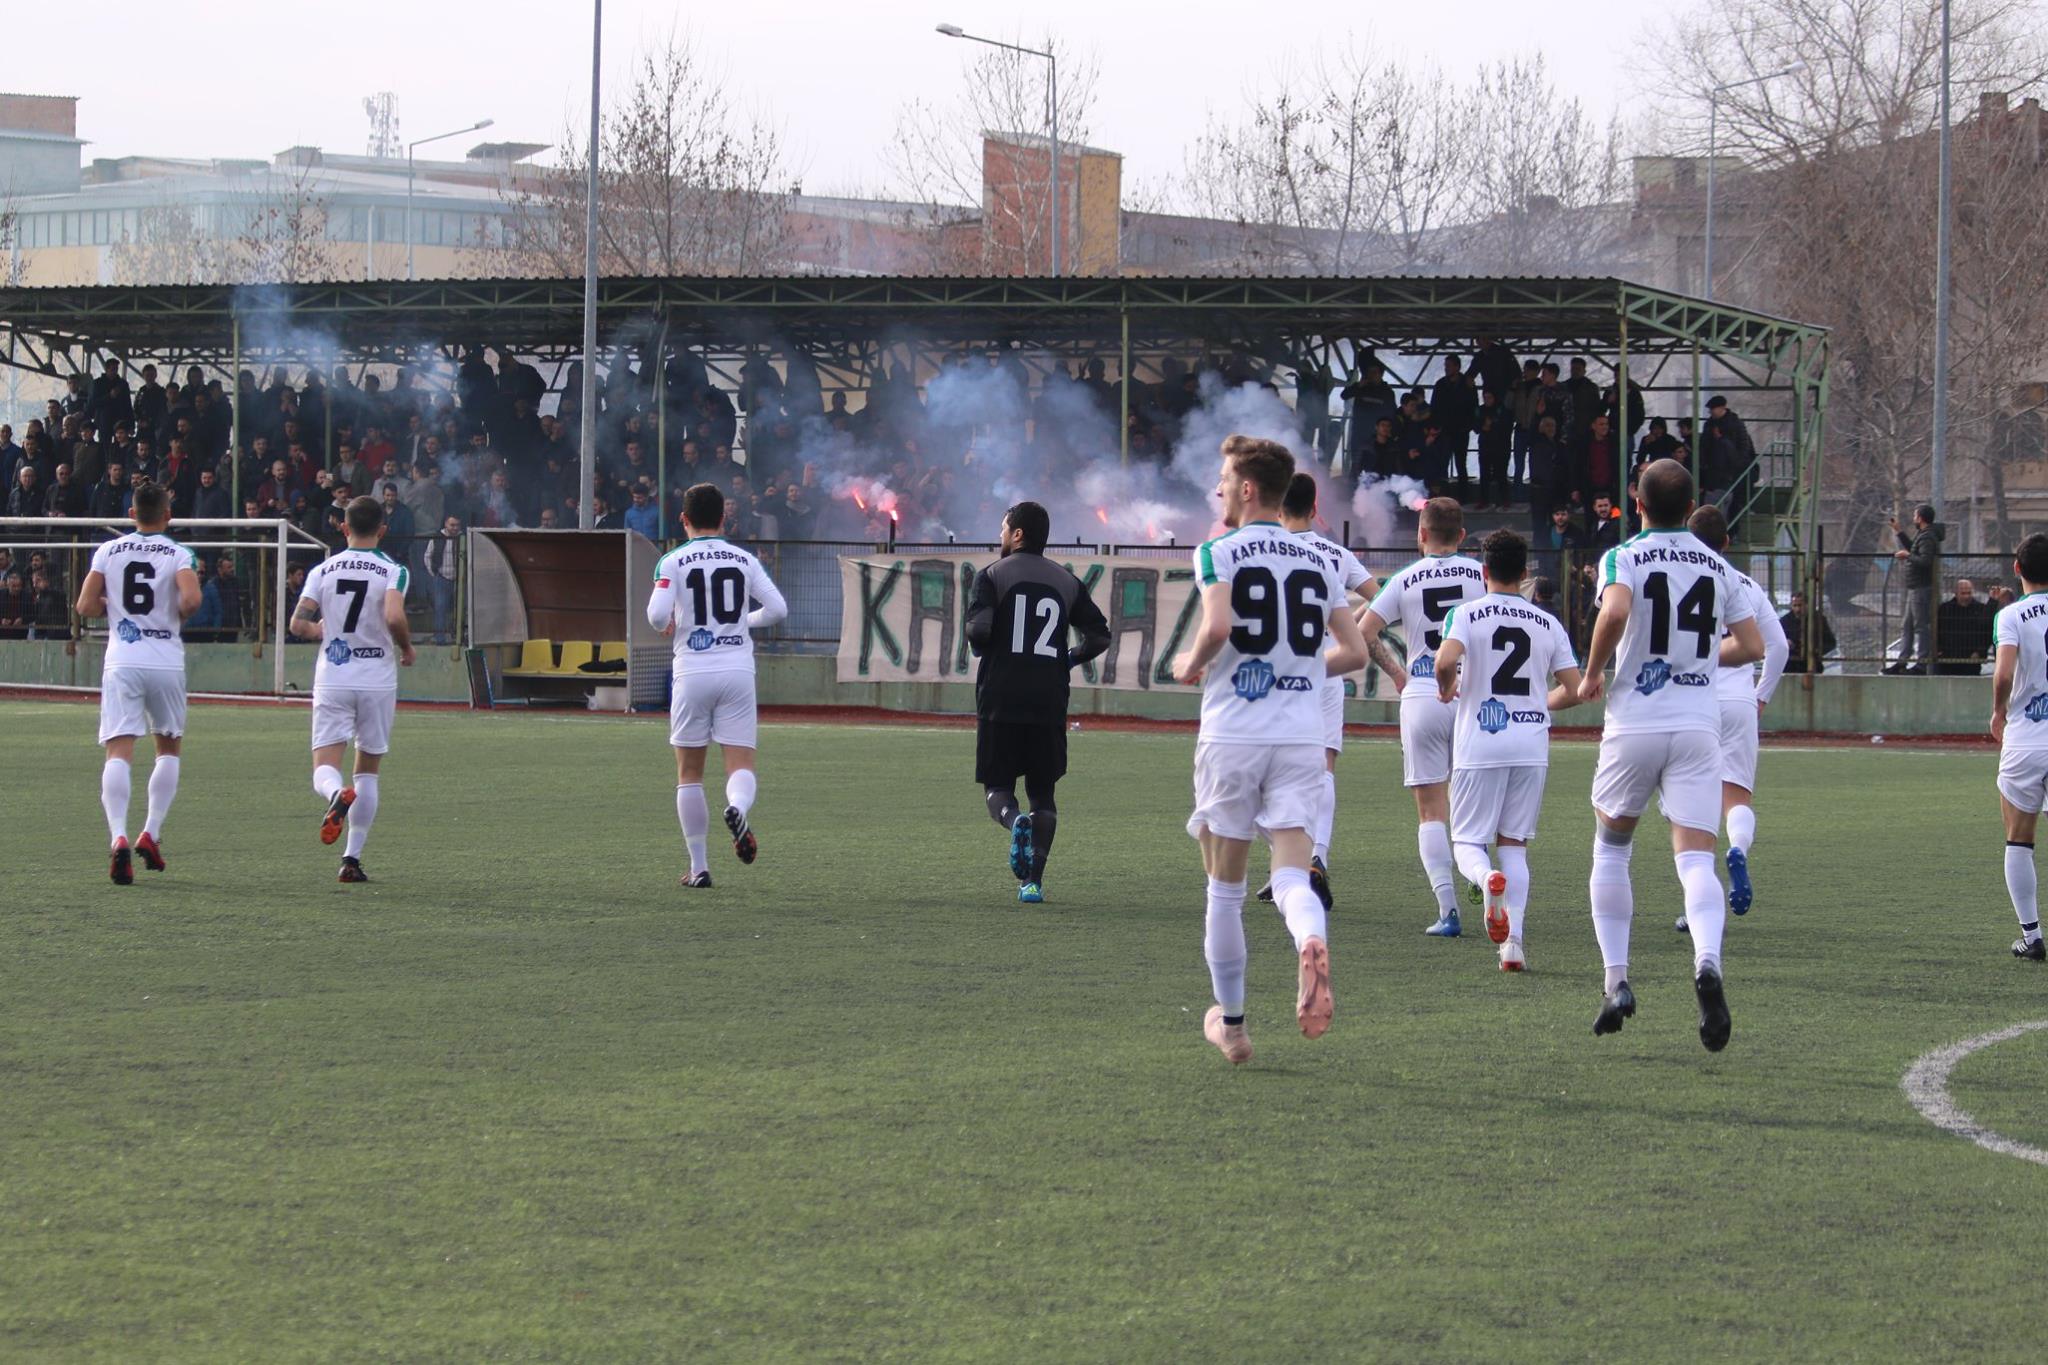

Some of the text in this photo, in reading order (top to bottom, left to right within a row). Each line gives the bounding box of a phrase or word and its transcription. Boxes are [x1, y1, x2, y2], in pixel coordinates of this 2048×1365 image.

[320, 560, 389, 578] KAFKASSPOR
[678, 551, 750, 568] KAFKASSPOR
[1231, 540, 1326, 571] KAFKASSPOR
[1403, 566, 1482, 592] KAFKASSPOR
[1633, 548, 1726, 577] KAFKASSPOR
[122, 561, 156, 616] 6
[336, 578, 370, 634] 7
[686, 566, 746, 626] 10
[1229, 566, 1329, 658] 96
[1643, 571, 1717, 660] 14
[1011, 594, 1060, 658] 12
[1422, 584, 1464, 652] 5
[1469, 604, 1551, 631] KAFKASSPOR
[1491, 625, 1531, 696] 2
